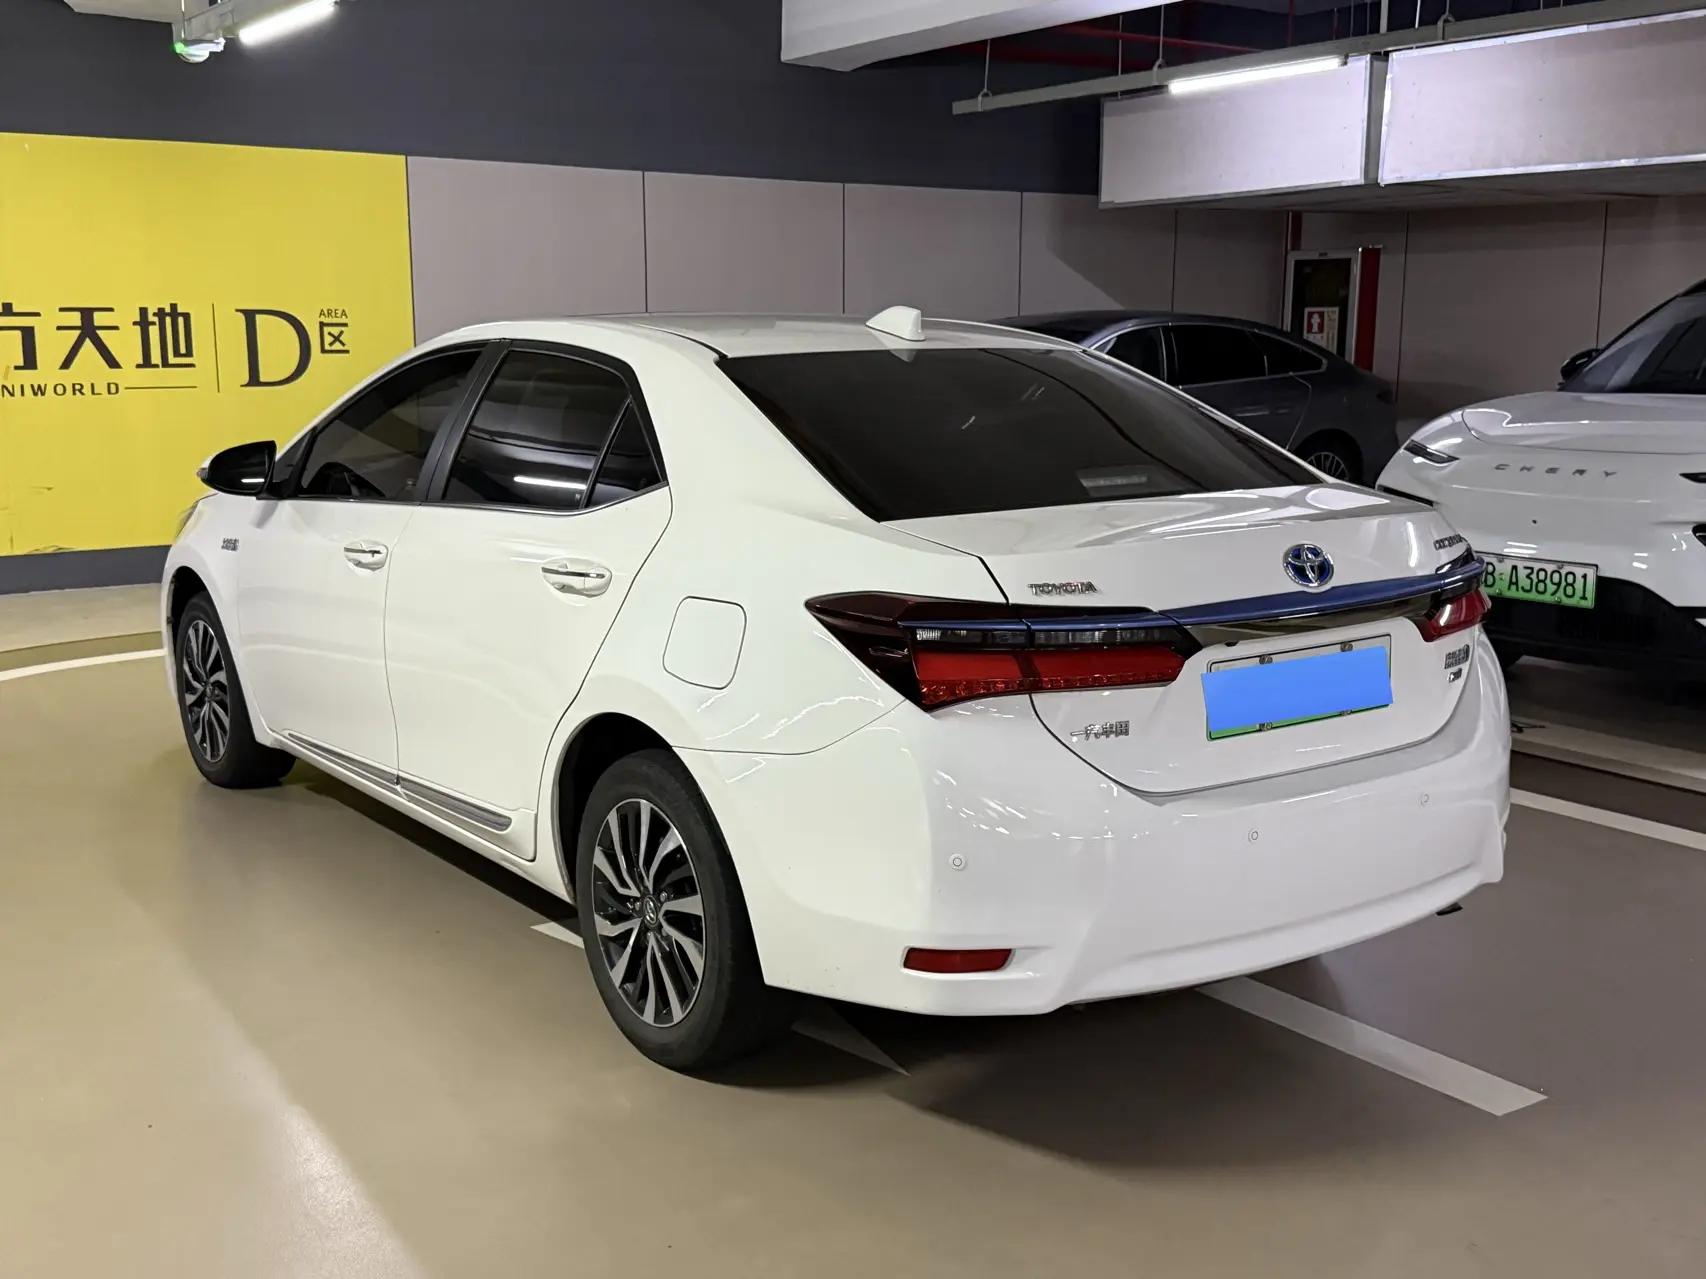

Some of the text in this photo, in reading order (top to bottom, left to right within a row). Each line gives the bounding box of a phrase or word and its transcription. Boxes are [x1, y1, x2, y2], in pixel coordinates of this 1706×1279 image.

[318, 308, 349, 319] AREA
[235, 308, 312, 387] D
[318, 320, 350, 354] 区
[1494, 463, 1617, 478] CHERY
[1028, 581, 1098, 596] TOYOTA
[1507, 564, 1588, 601] A38981
